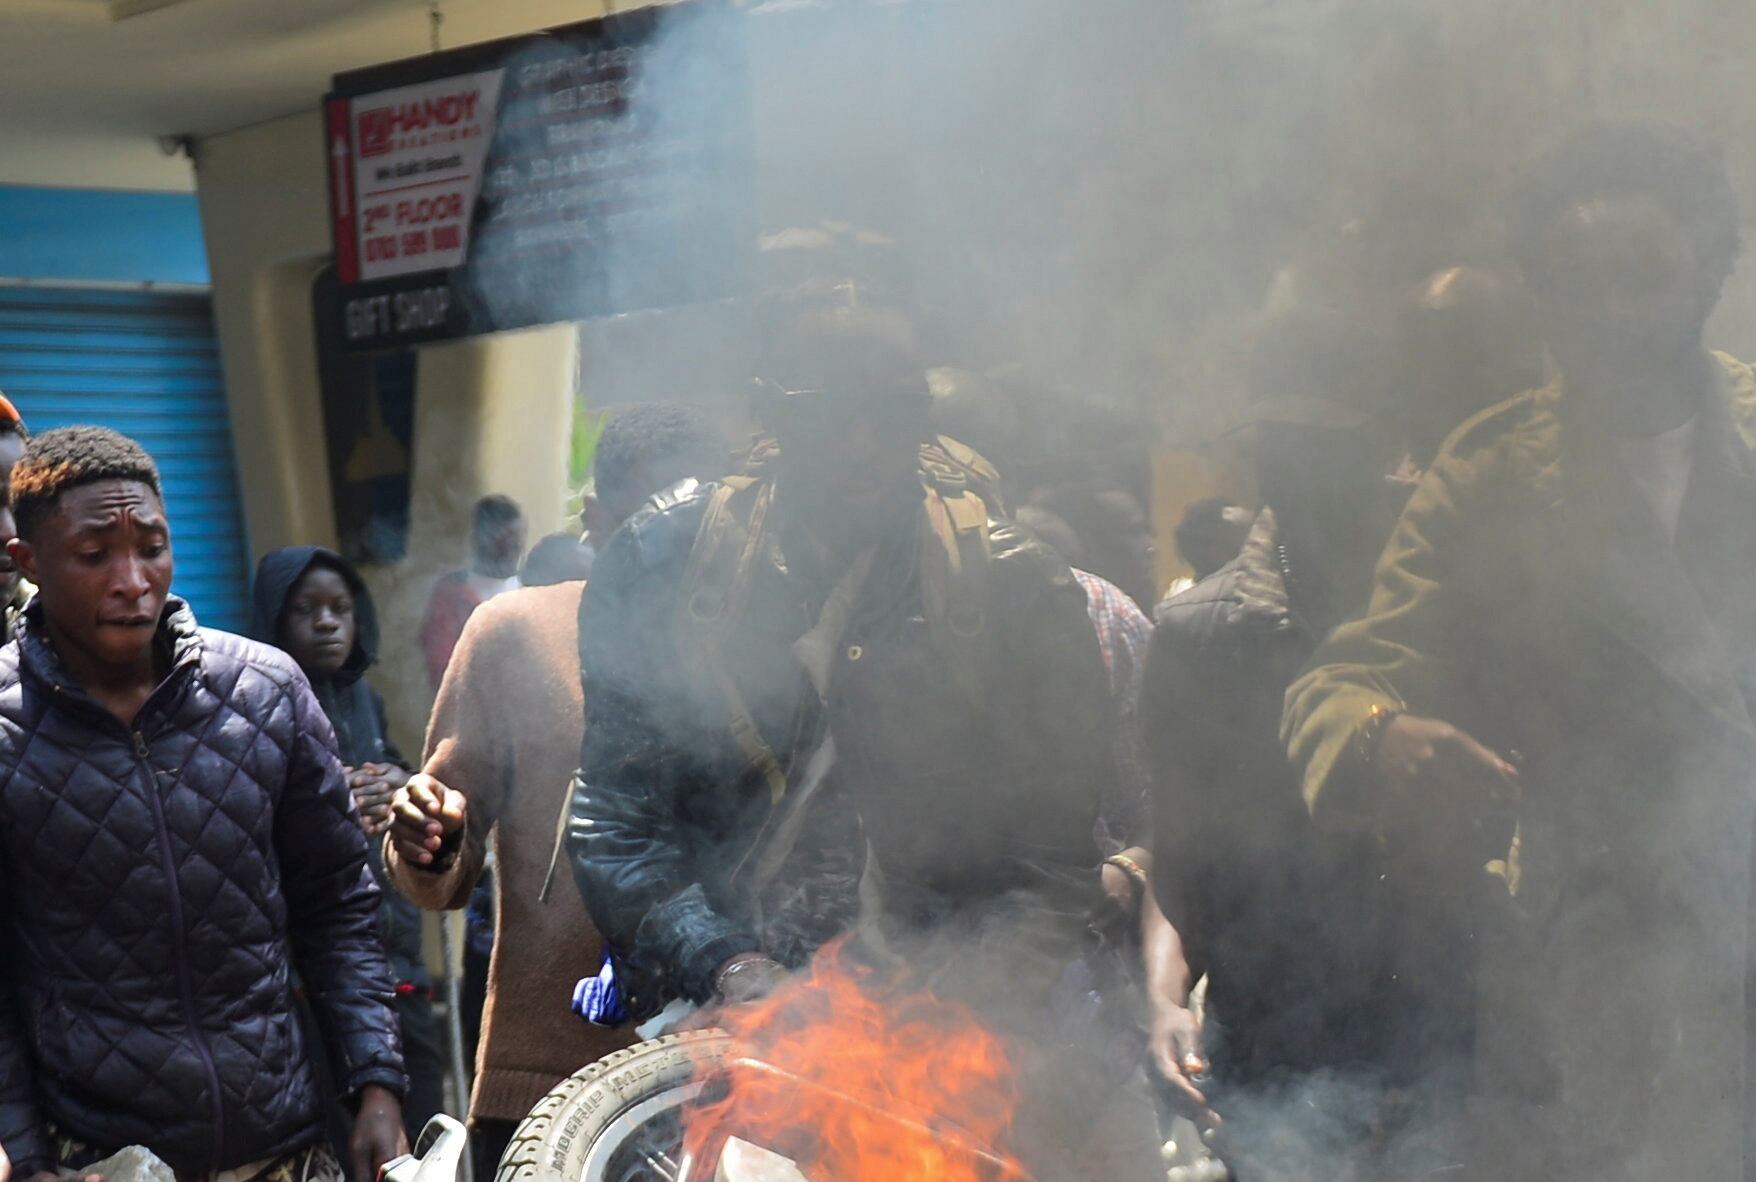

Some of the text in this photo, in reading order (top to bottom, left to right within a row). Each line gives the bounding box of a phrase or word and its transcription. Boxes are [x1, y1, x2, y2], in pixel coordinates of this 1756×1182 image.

[396, 193, 464, 227] FLOOR
[346, 285, 450, 340] GIFT SHOP
